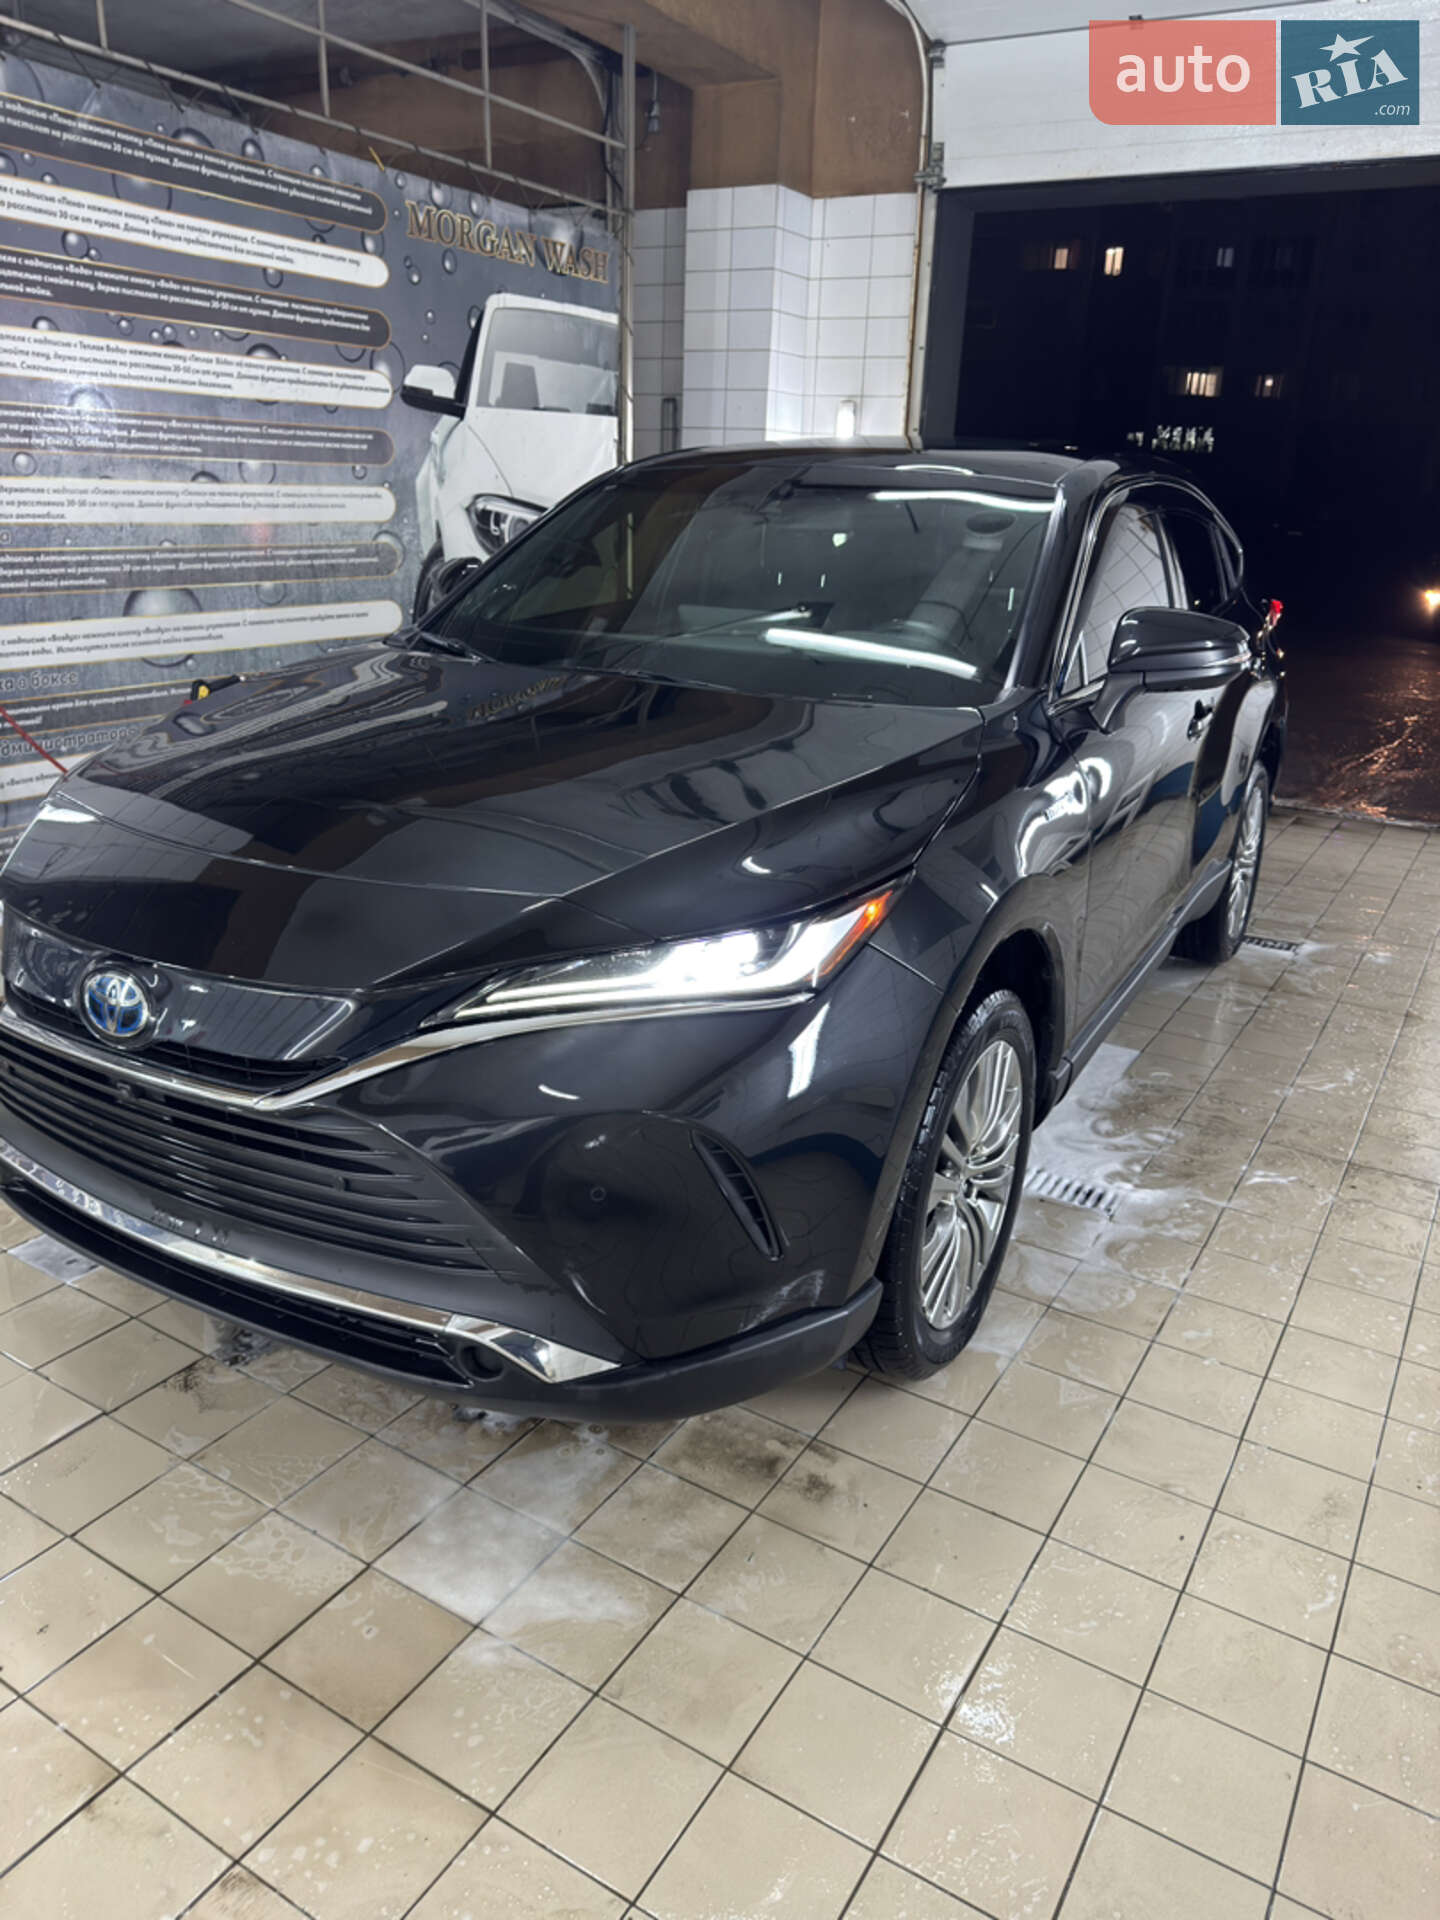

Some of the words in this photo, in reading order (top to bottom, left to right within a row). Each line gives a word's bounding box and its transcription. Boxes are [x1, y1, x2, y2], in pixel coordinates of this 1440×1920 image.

[404, 199, 536, 267] MORGAN
[542, 235, 608, 283] WASH
[31, 671, 79, 689] боксе
[0, 725, 138, 757] дмиистратора
